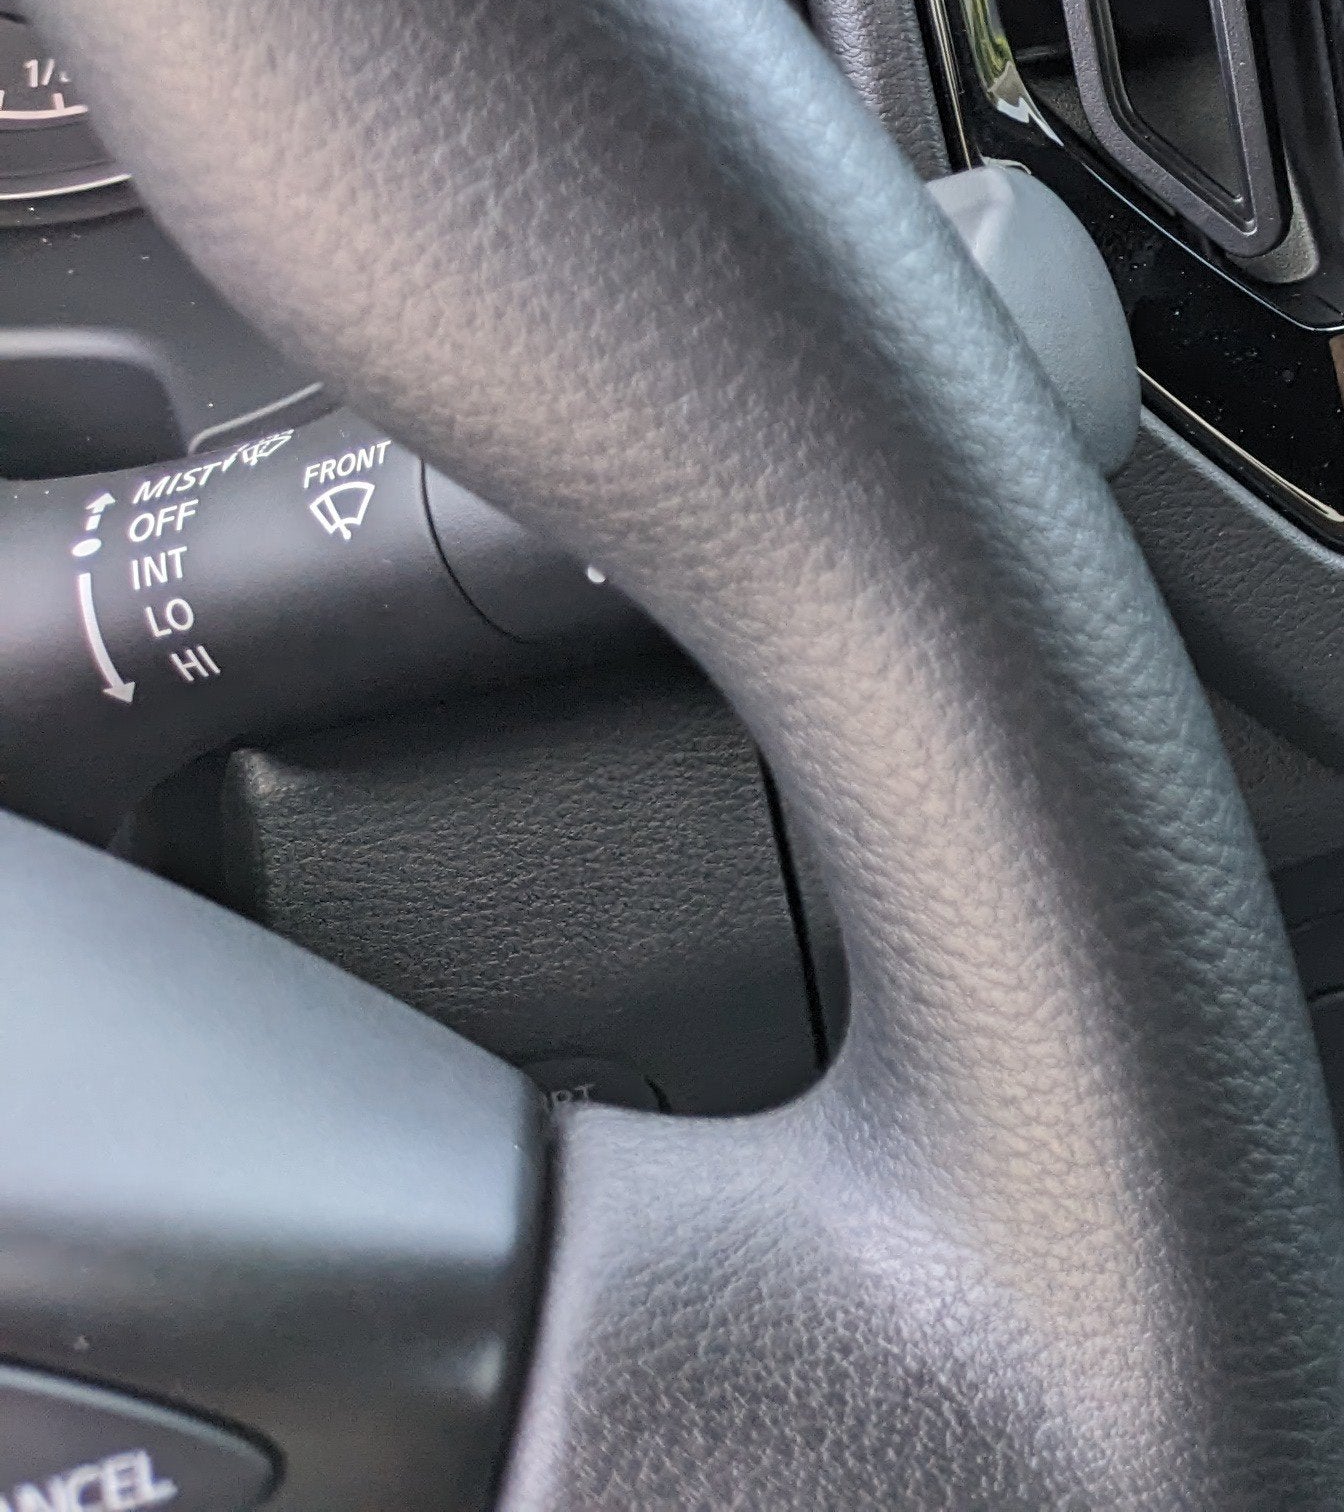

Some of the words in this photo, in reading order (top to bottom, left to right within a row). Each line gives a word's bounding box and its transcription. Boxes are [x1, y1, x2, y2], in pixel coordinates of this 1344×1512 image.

[132, 464, 222, 505] MIST
[302, 439, 393, 488] FRONT
[128, 500, 199, 543] OFF
[130, 545, 189, 591] INT
[145, 597, 196, 639] LO
[170, 645, 221, 682] HI
[0, 1449, 178, 1512] NCEL
